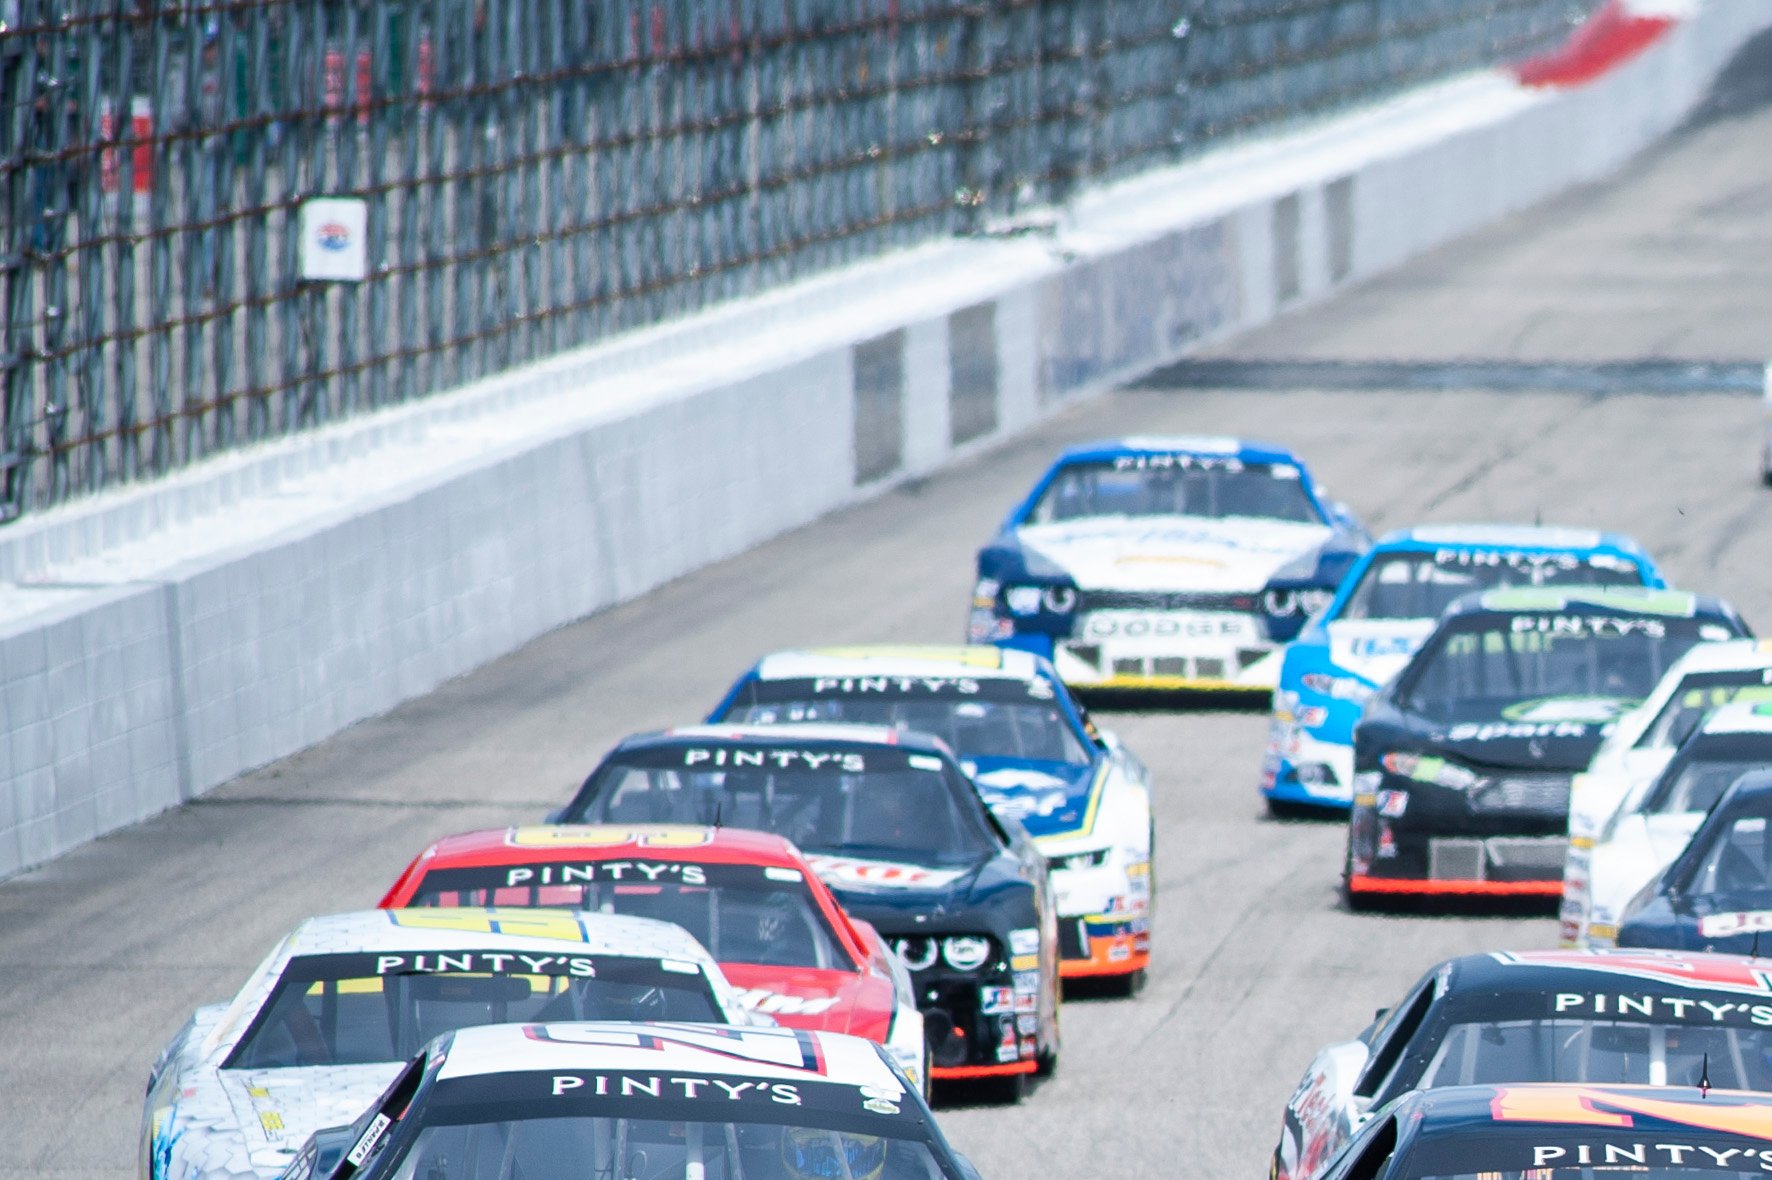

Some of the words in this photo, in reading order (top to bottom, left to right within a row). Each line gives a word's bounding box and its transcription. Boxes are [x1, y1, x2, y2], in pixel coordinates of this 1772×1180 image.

[1512, 616, 1665, 638] PINTY'S
[815, 677, 979, 694] PINTY'S
[686, 749, 864, 772] PINTY'S
[508, 860, 707, 885] PINTY'S
[378, 954, 596, 978] PINTY'S
[552, 1075, 802, 1105] PINTY'S
